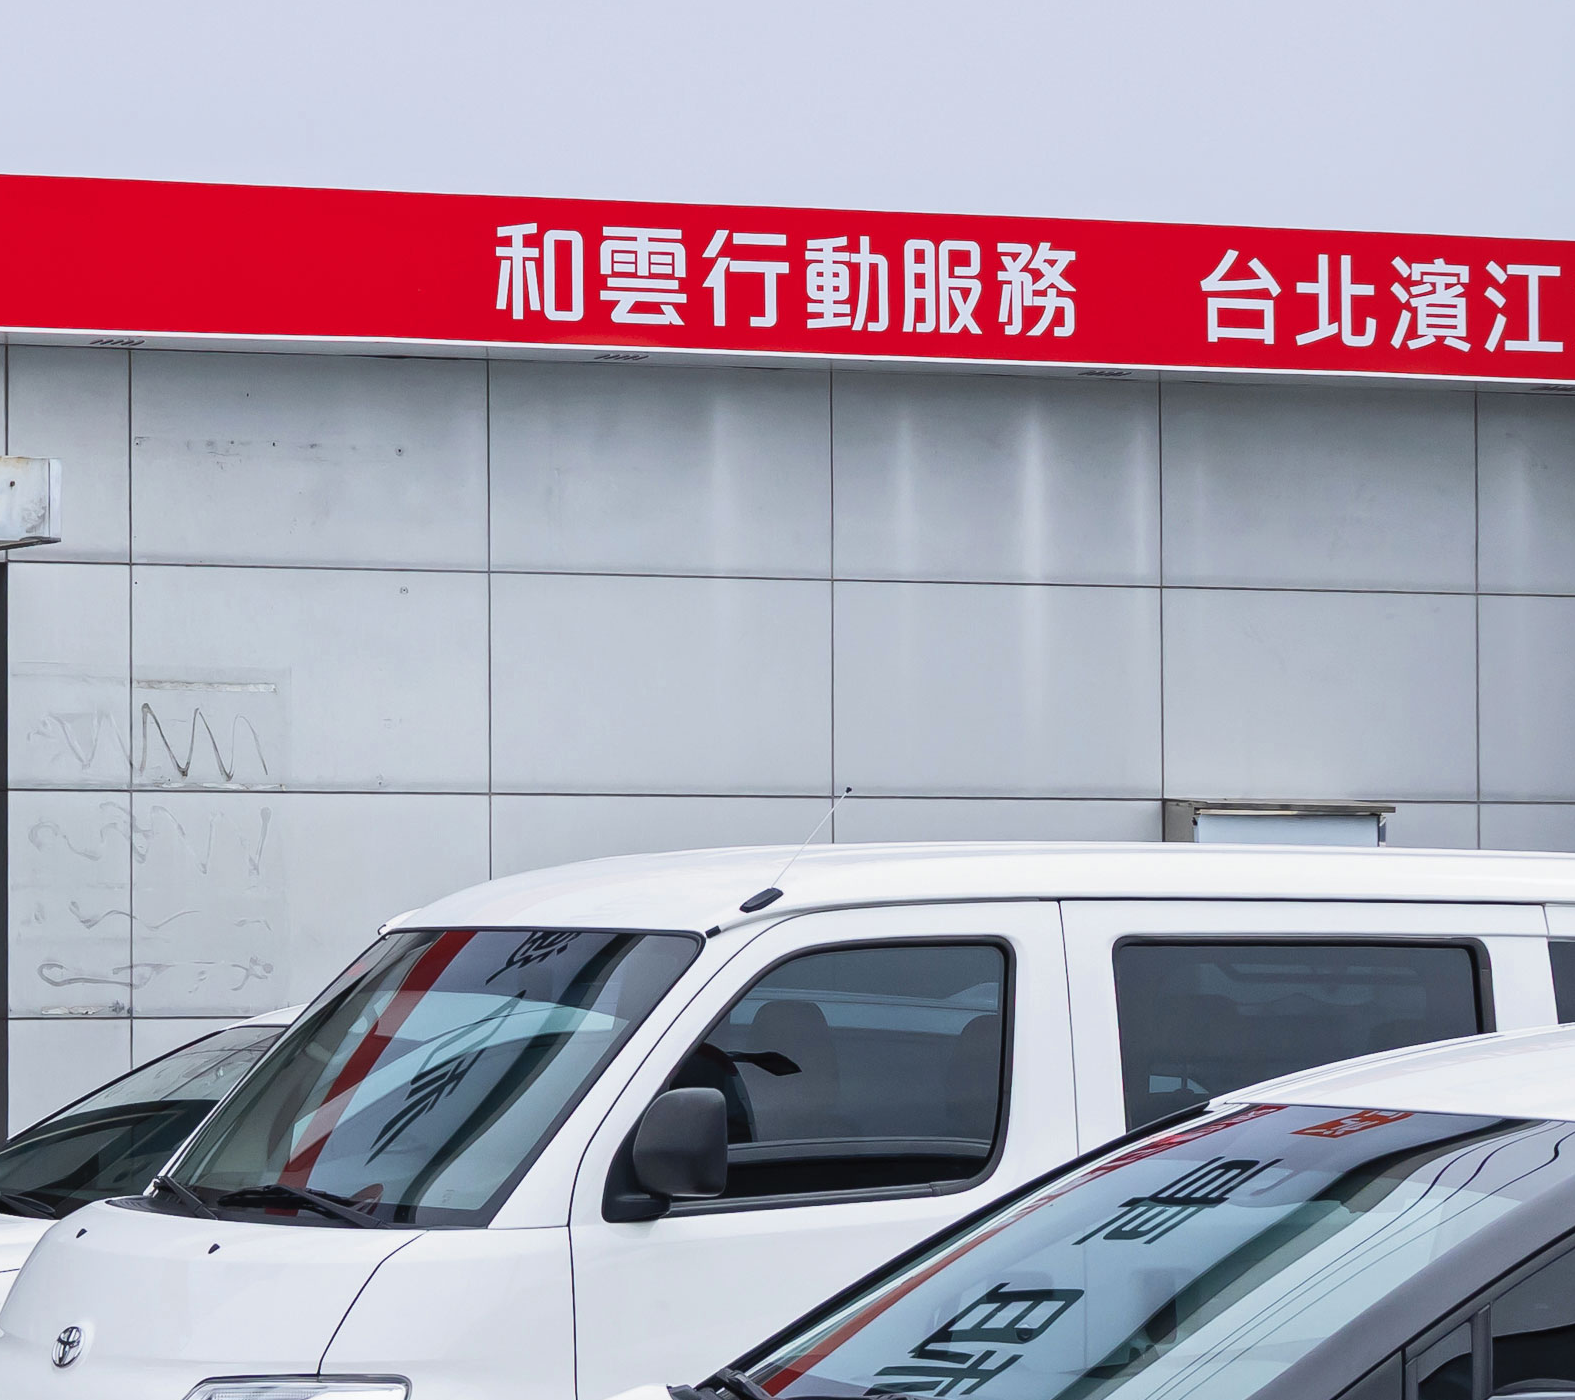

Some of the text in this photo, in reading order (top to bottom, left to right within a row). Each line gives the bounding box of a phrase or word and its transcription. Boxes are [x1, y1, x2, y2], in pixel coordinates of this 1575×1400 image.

[495, 221, 1077, 339] 和雲行動服務
